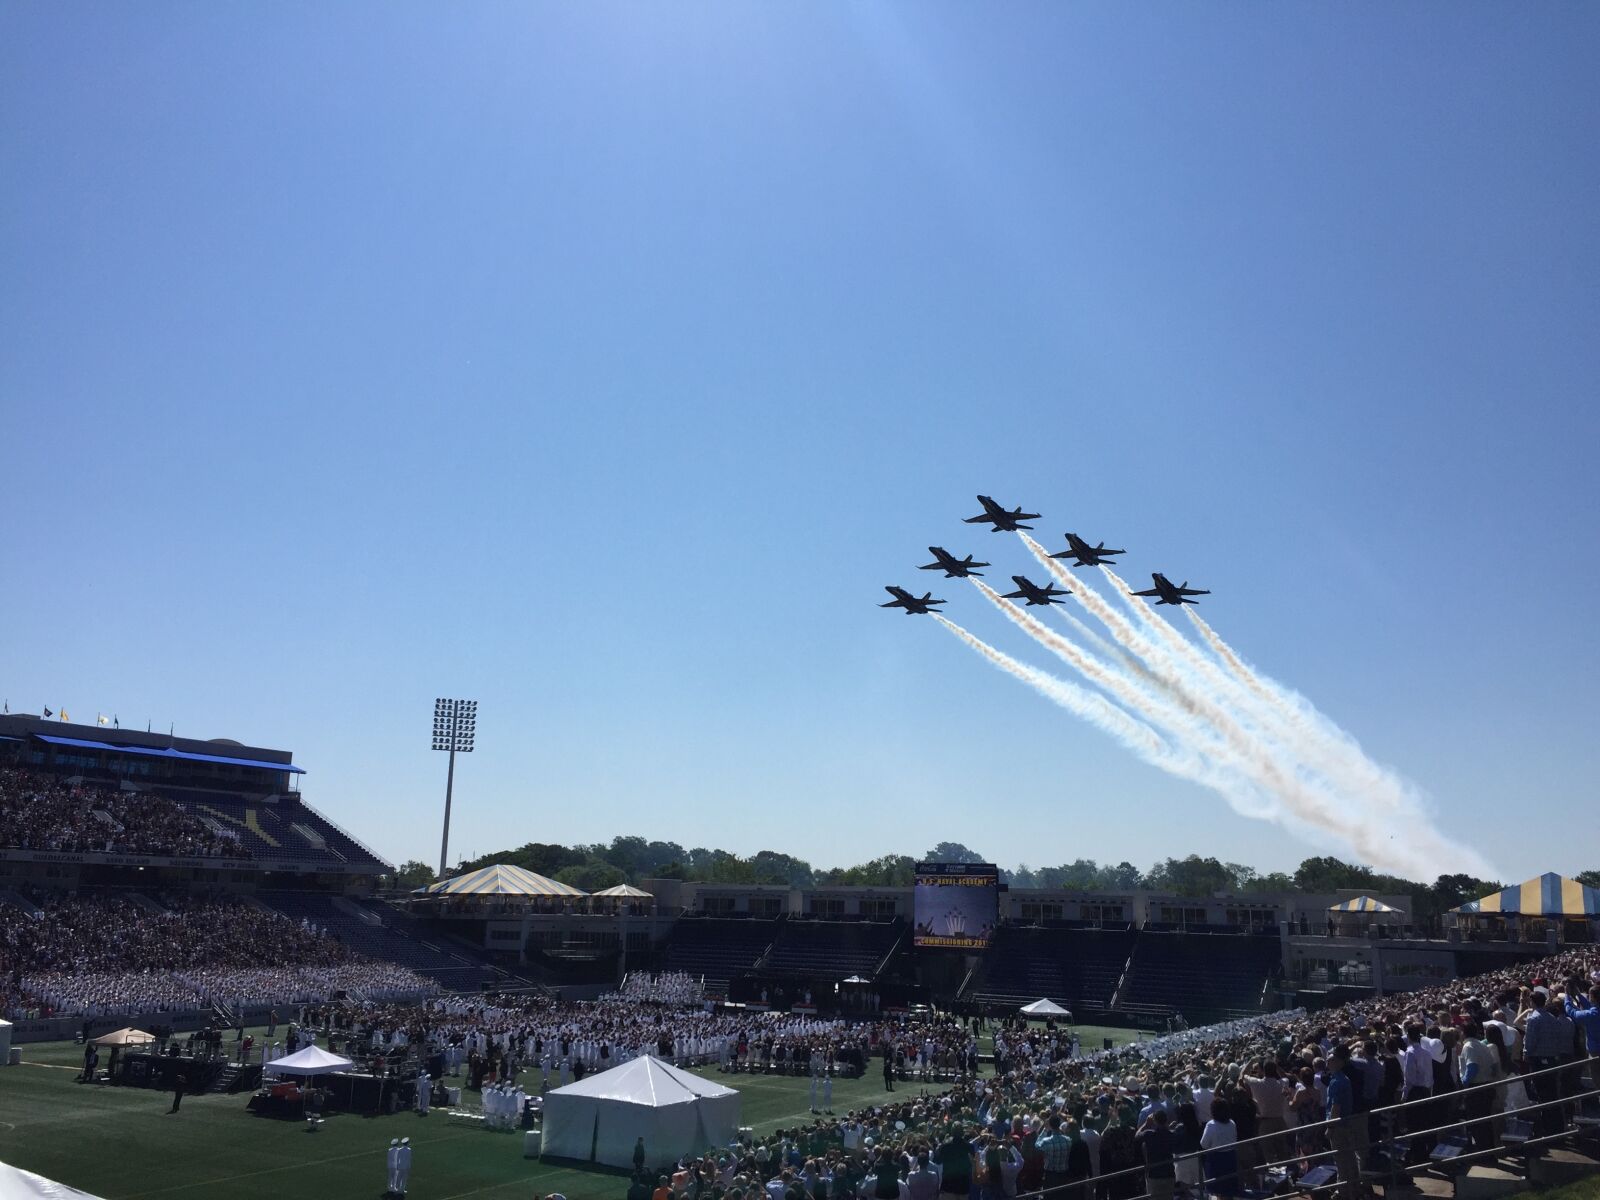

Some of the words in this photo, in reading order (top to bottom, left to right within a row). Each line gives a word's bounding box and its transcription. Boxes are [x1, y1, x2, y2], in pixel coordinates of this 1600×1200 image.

[937, 878, 956, 886] NAVAL
[958, 878, 988, 886] ACADEMY
[921, 937, 973, 946] COMMISSIONING
